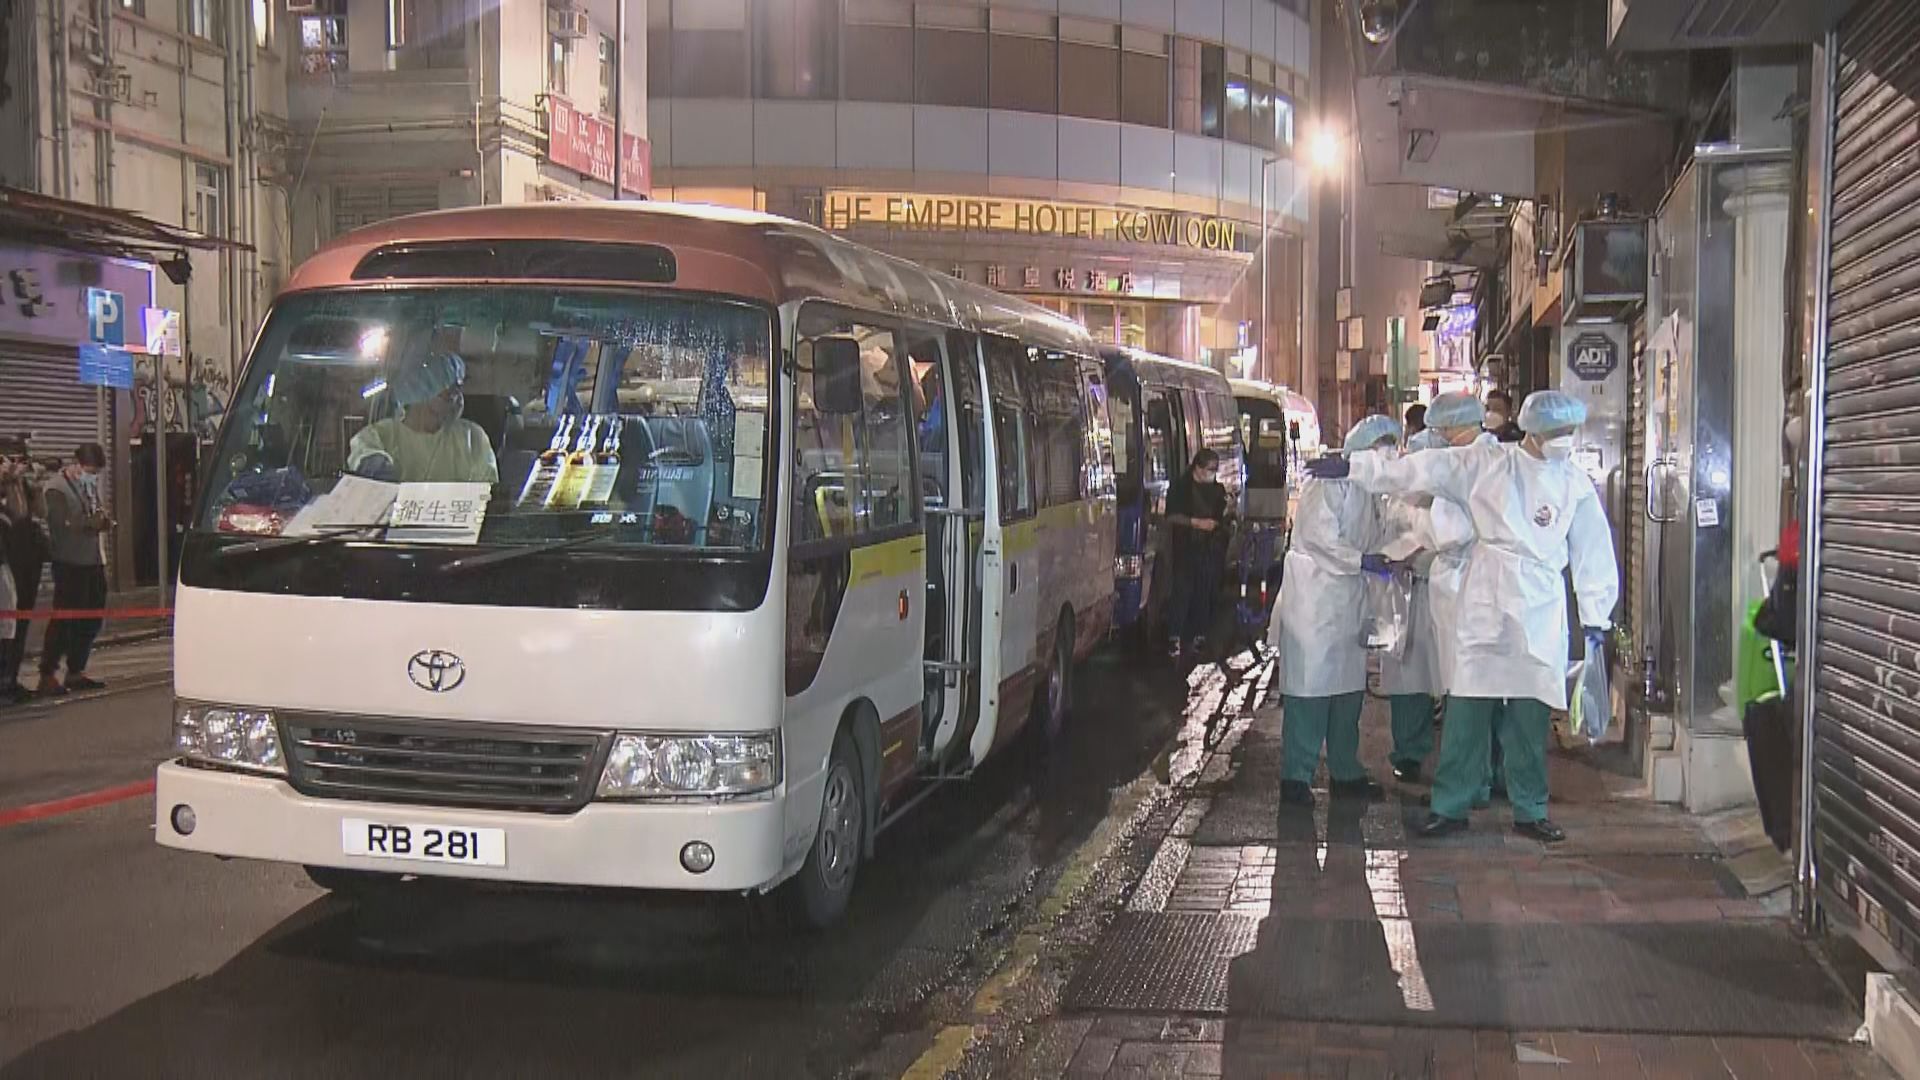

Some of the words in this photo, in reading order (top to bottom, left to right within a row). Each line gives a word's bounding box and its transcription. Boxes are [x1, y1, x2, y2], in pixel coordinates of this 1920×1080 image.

[804, 195, 872, 229] THE
[886, 198, 1001, 233] EMPIRE
[1015, 203, 1101, 240] HOTEL
[1115, 210, 1235, 251] KOWLOON
[96, 295, 118, 340] P
[1576, 347, 1611, 366] ADT
[400, 500, 474, 523] 衛生署
[368, 824, 411, 854] RB
[424, 829, 478, 859] 281
